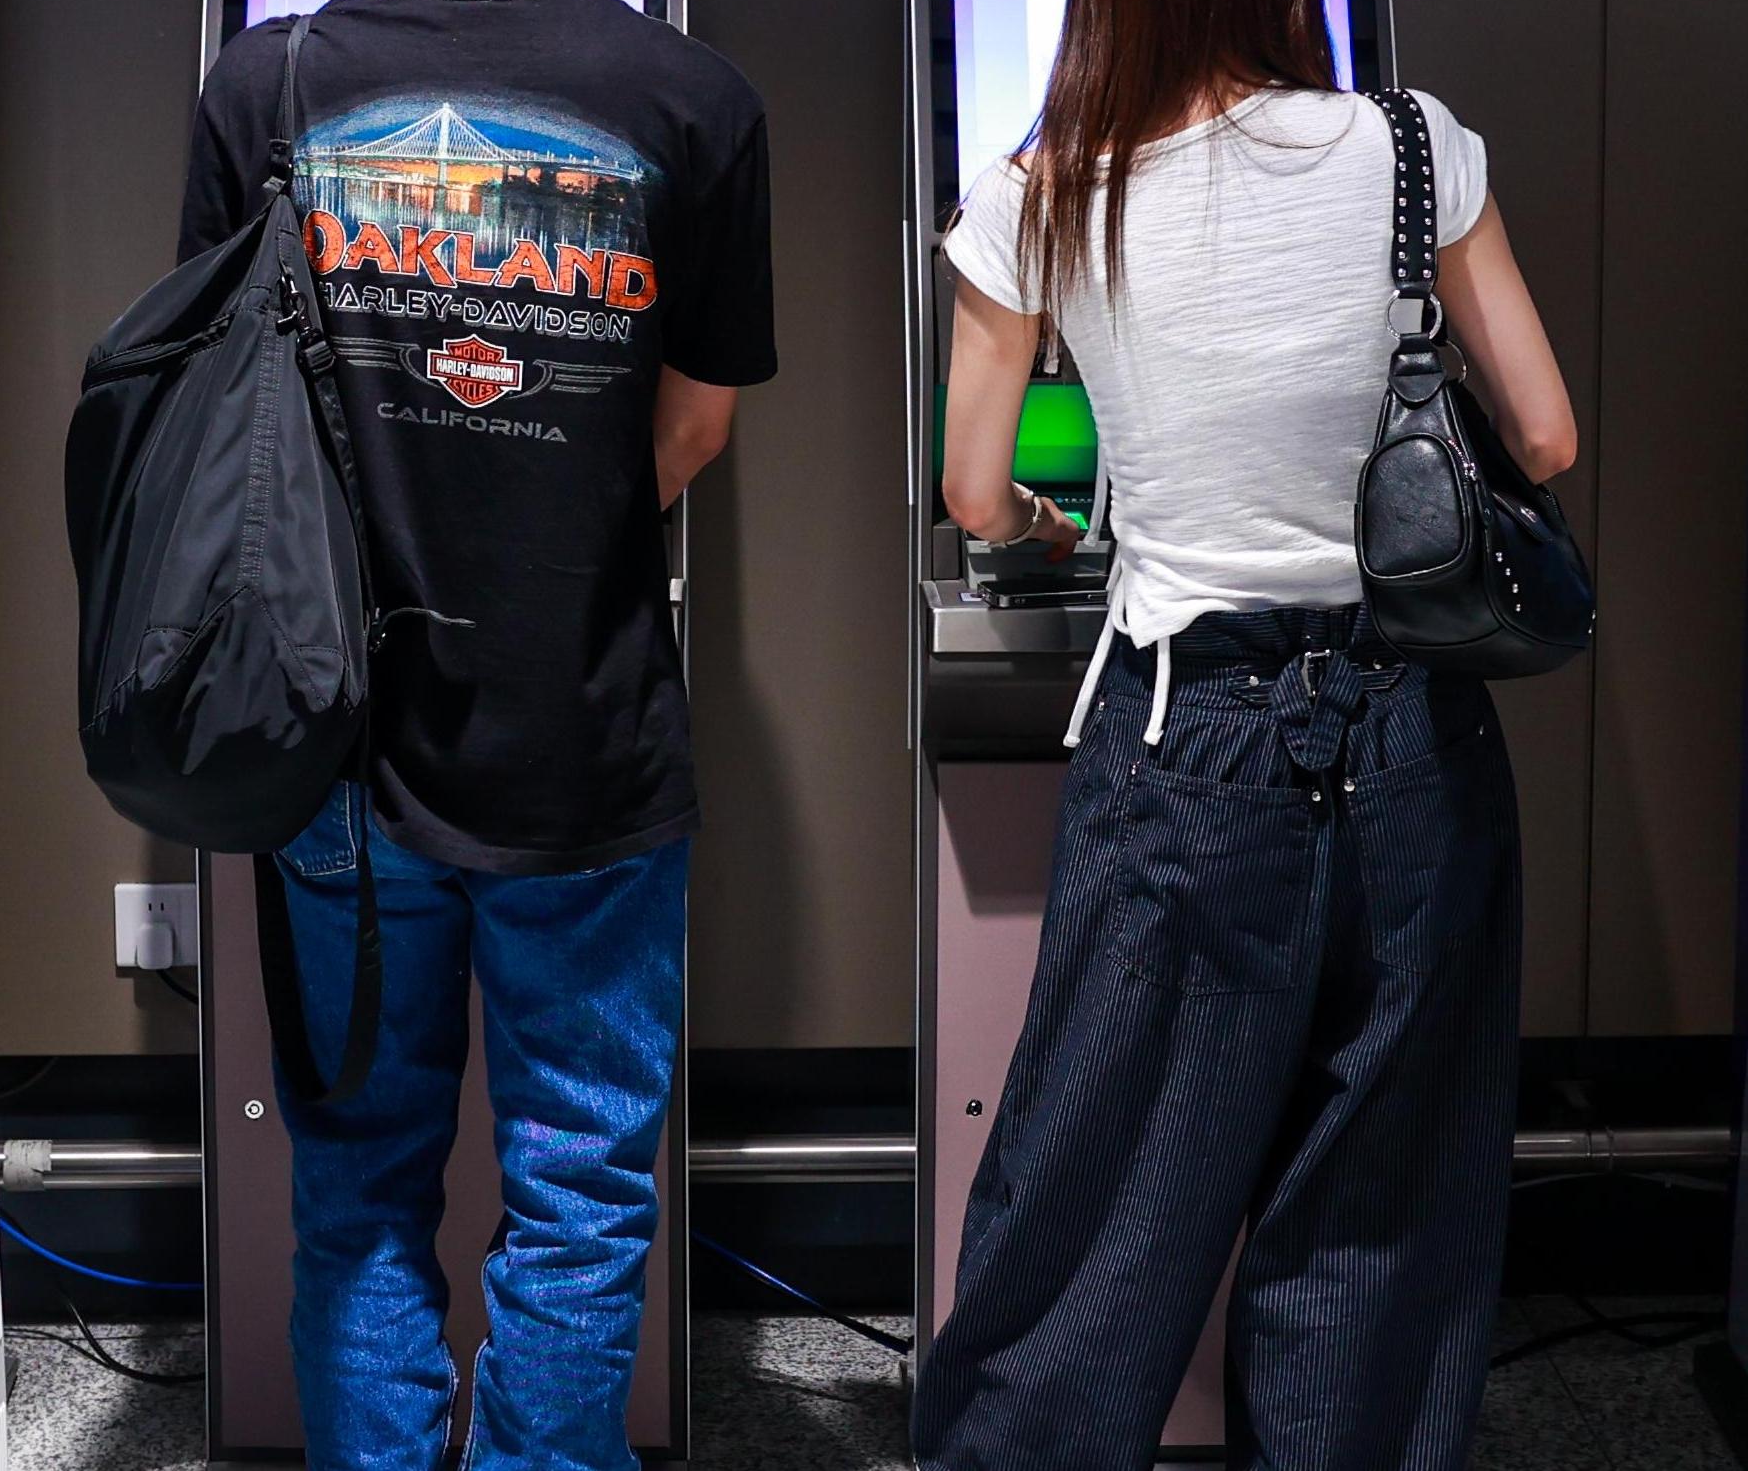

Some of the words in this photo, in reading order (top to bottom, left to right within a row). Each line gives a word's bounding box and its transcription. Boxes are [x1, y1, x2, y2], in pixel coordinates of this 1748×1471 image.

[303, 209, 658, 311] OAKLAND
[318, 281, 631, 341] HARLEY-DAVIDSON
[435, 358, 514, 383] HARLEY-DAVIDSON
[454, 346, 496, 362] MOTOR
[452, 380, 494, 401] CYCLES
[376, 402, 568, 443] CALIFORNIA
